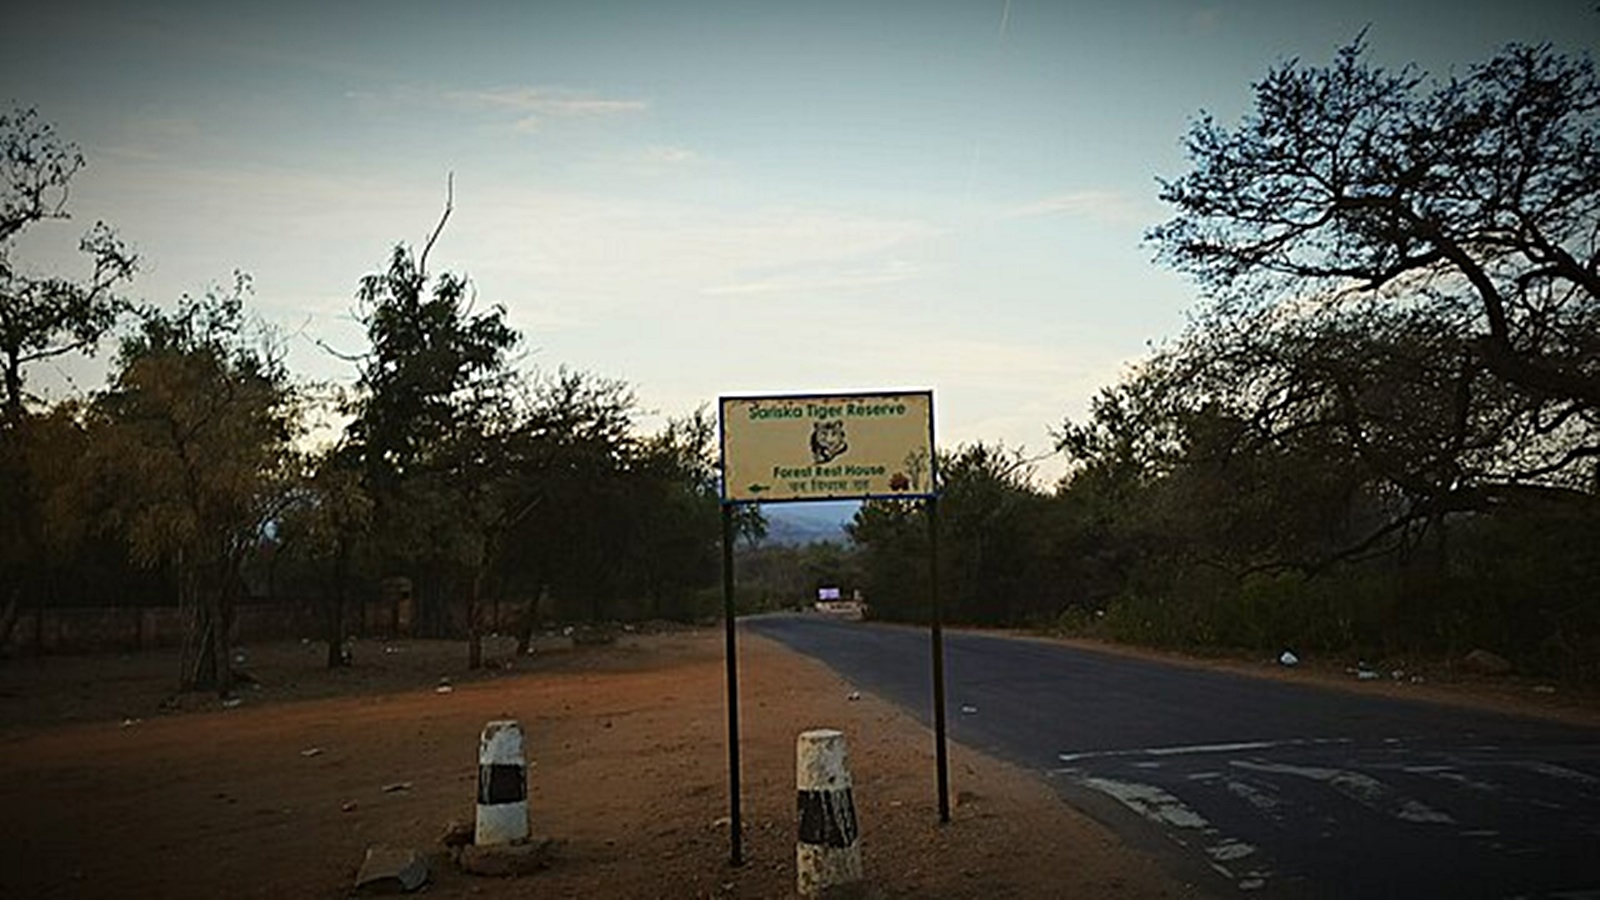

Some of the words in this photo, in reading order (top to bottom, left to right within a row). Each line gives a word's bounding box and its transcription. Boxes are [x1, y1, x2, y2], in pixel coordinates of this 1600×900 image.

[748, 404, 803, 420] Sariska
[807, 404, 842, 420] Tiger
[847, 403, 906, 416] Reserve
[773, 466, 812, 478] Forest
[816, 466, 842, 477] Rest
[845, 465, 886, 477] House
